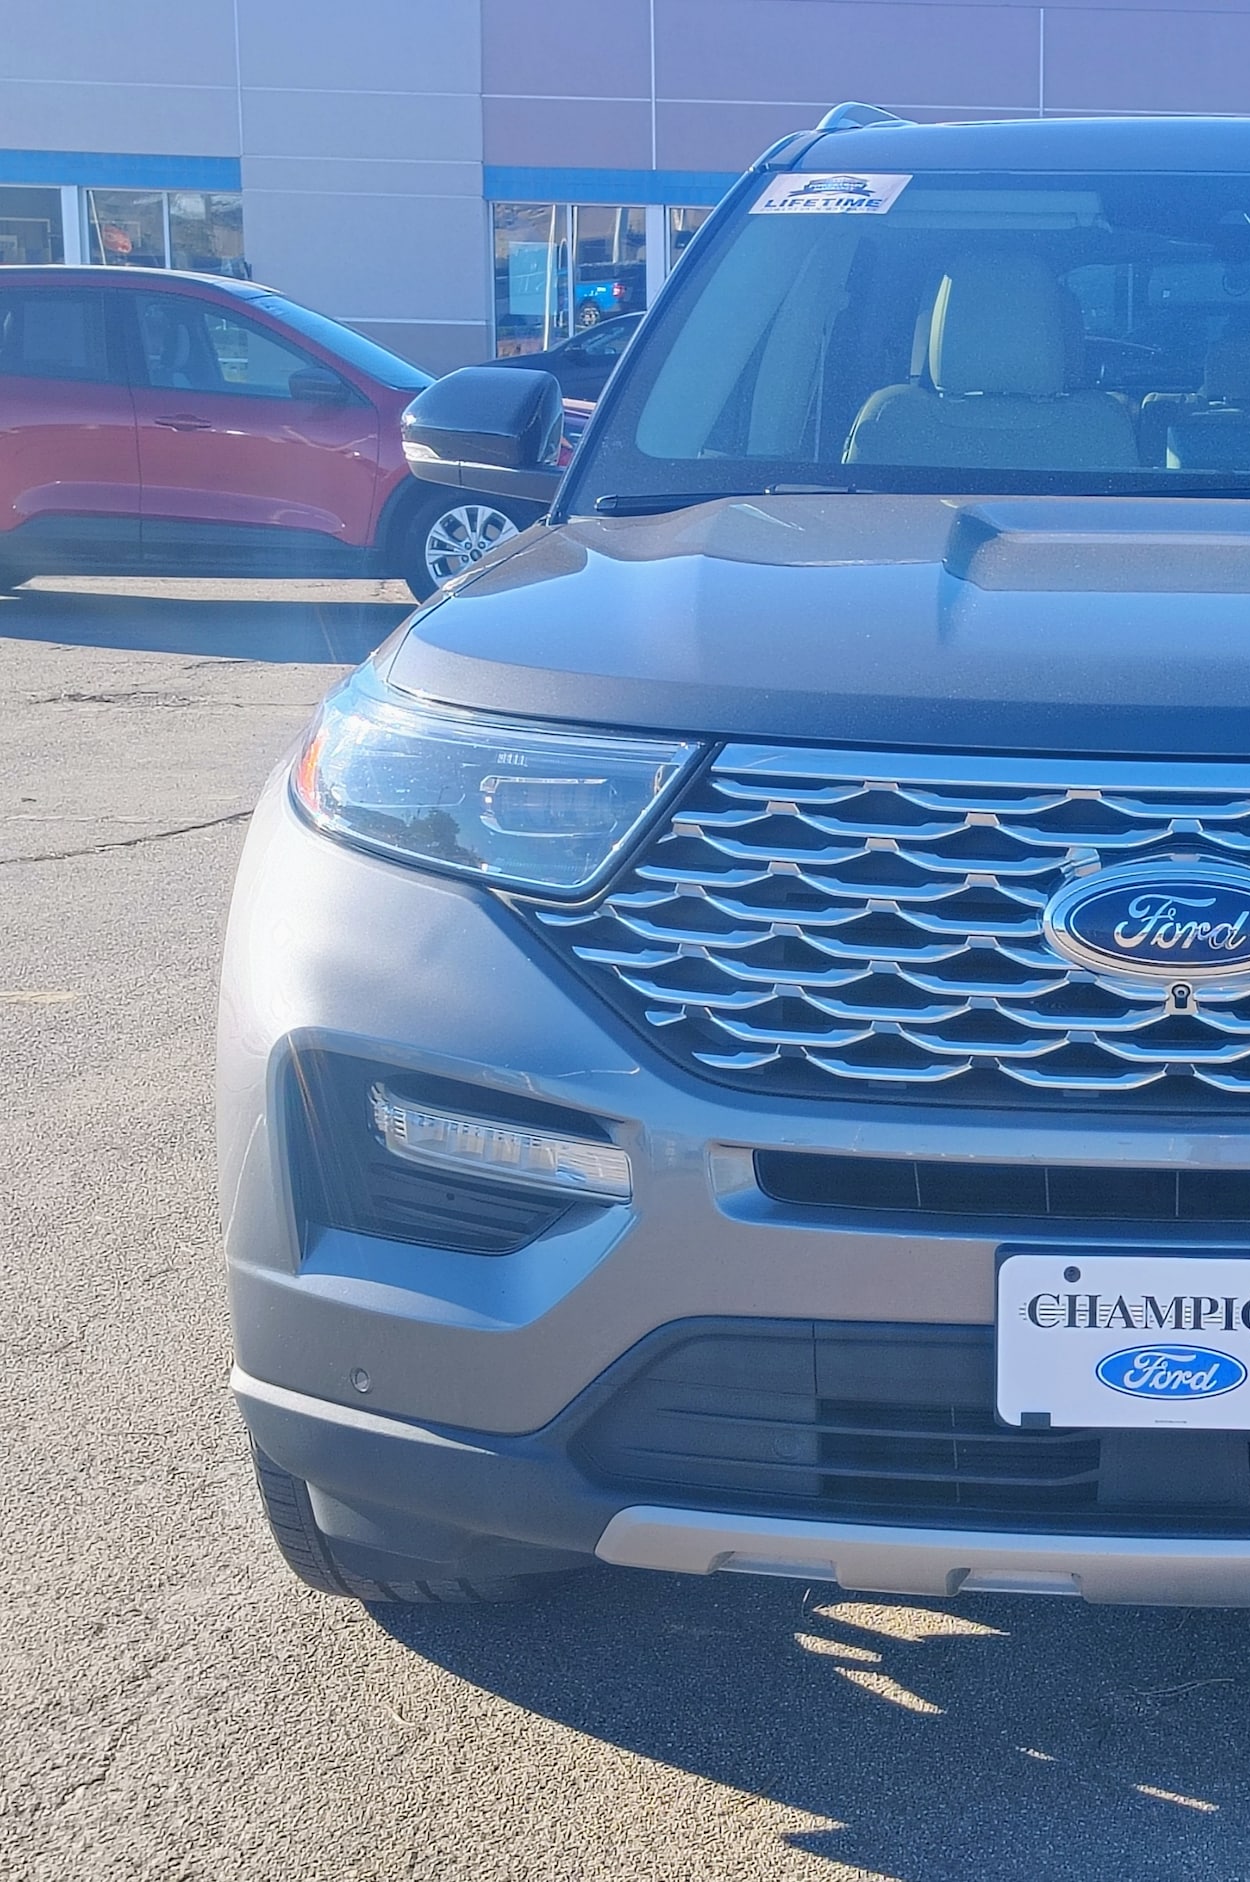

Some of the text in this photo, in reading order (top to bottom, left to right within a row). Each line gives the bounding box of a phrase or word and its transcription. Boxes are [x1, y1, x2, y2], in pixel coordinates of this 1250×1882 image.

[764, 198, 883, 208] LIFETIME
[1114, 893, 1249, 951] Ford
[1123, 1351, 1219, 1391] Ford
